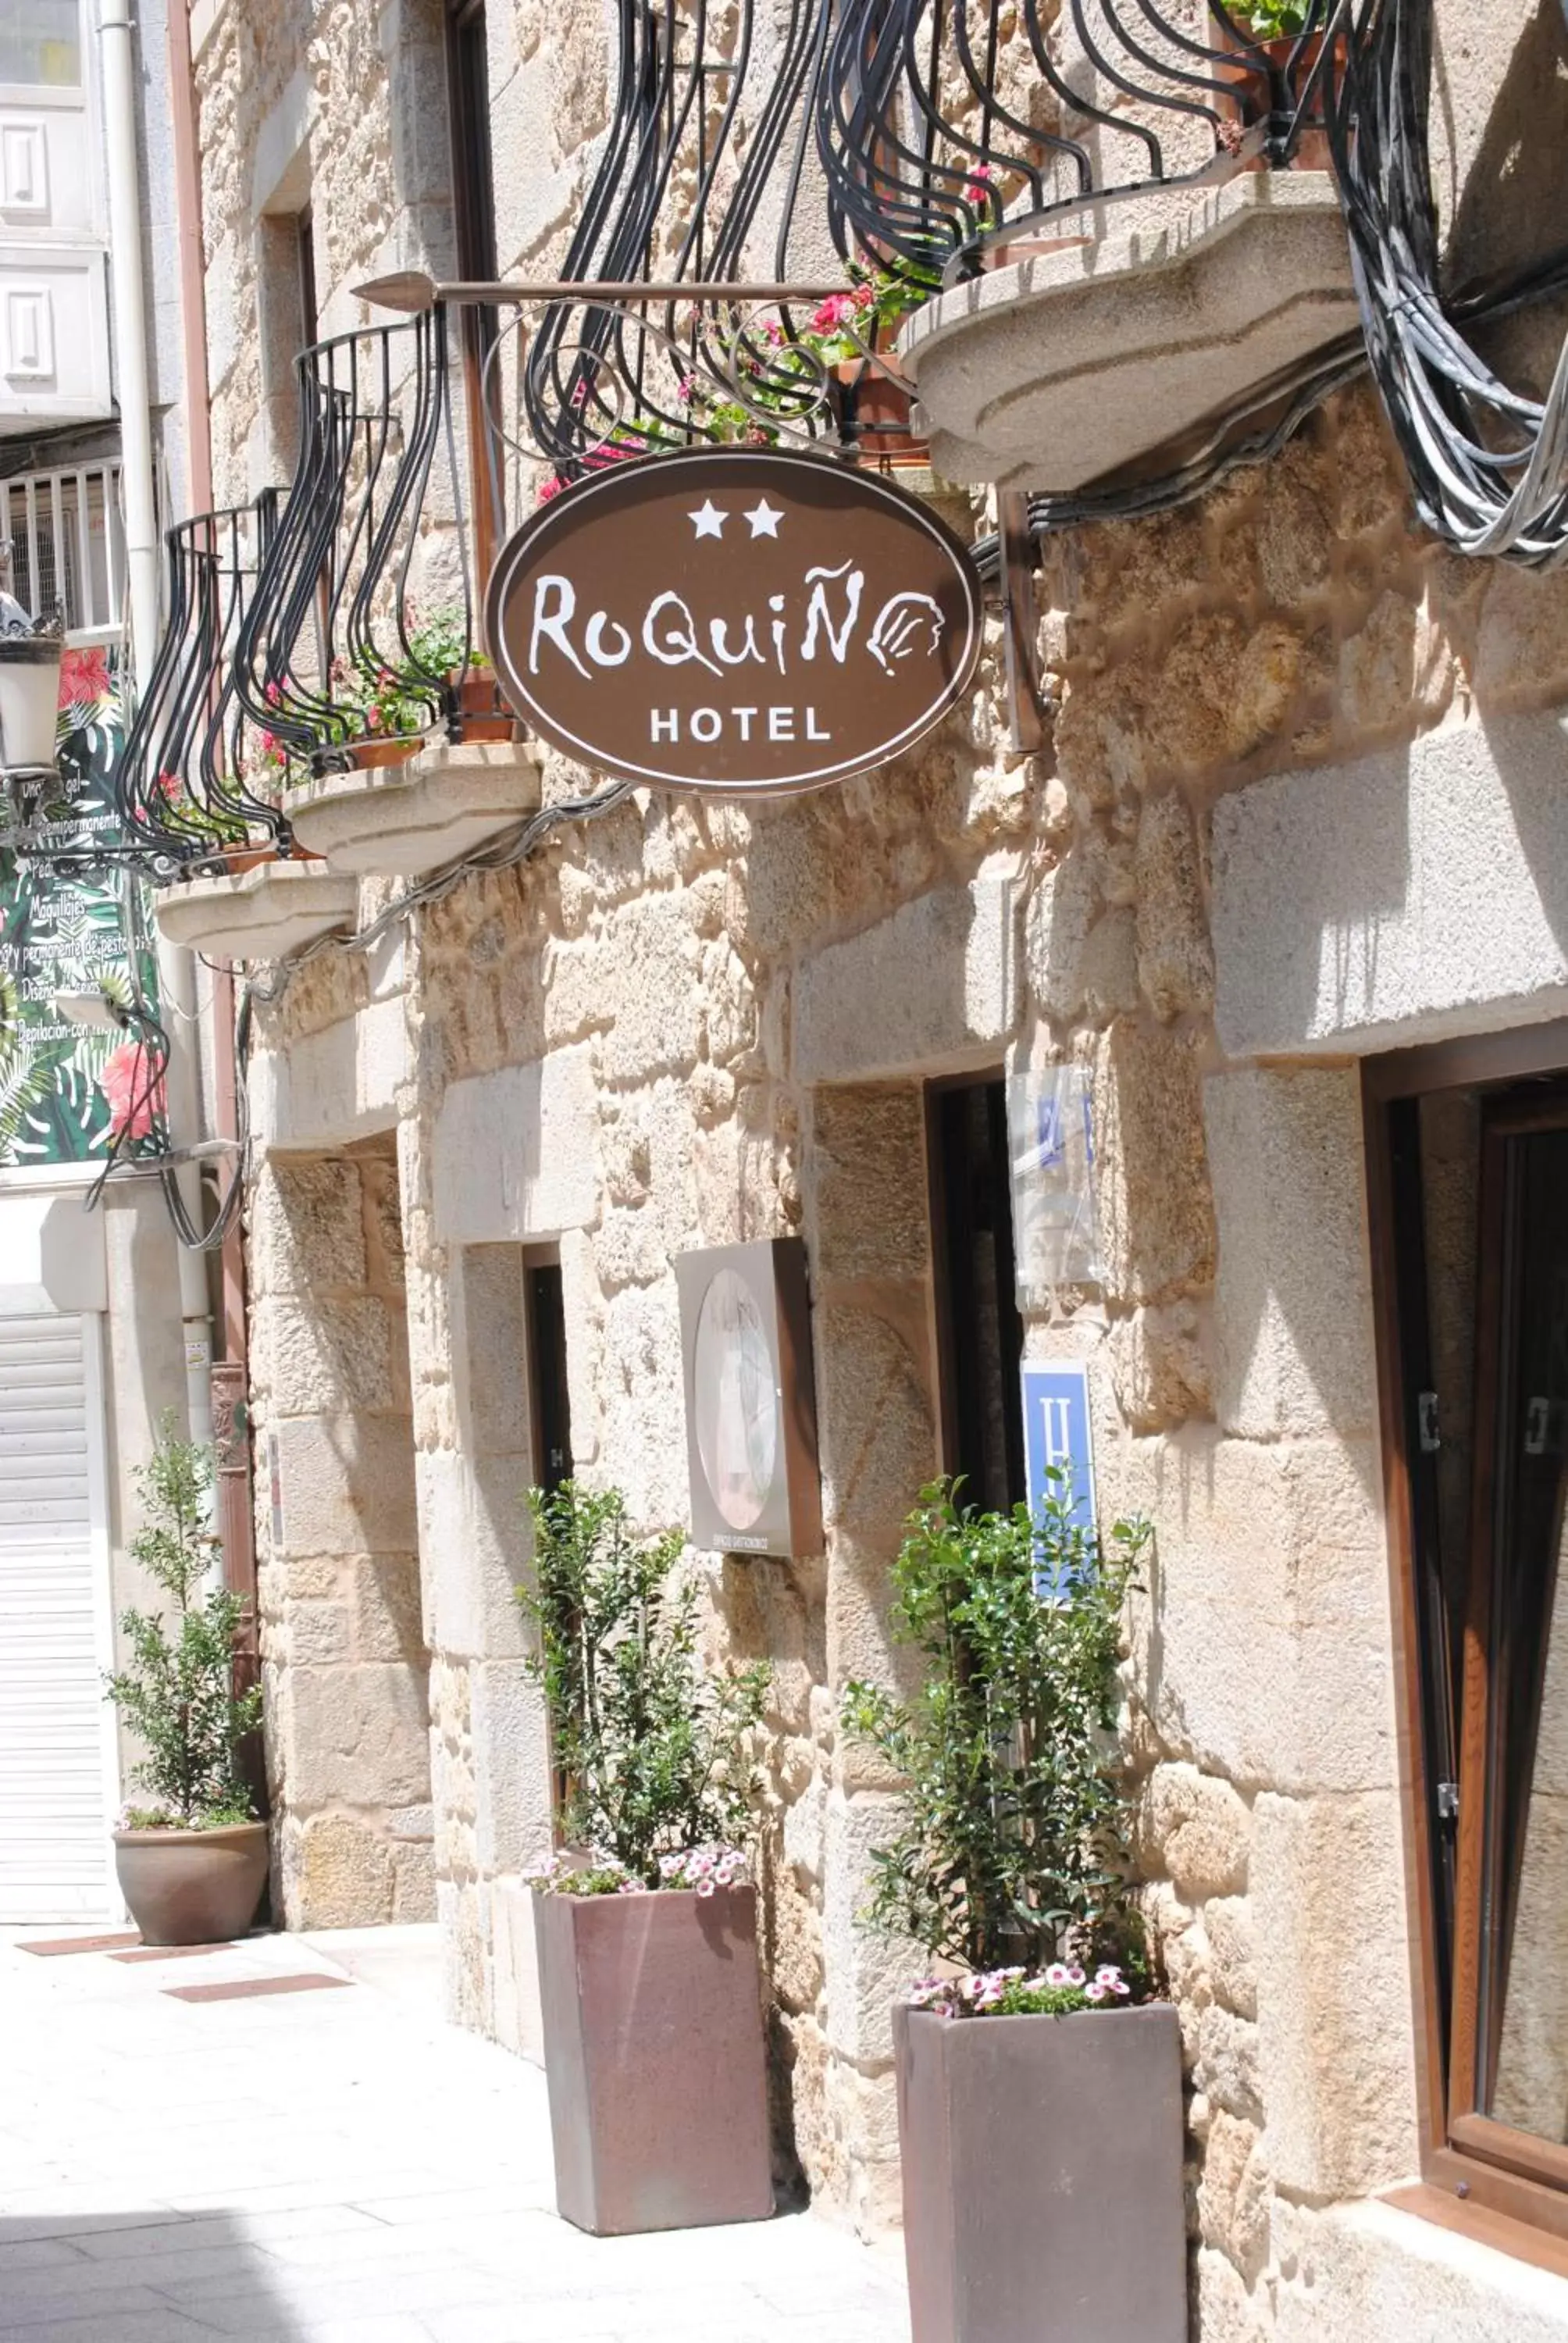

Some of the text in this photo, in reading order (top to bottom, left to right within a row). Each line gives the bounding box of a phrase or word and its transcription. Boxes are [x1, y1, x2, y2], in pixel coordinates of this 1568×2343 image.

[650, 706, 832, 743] HOTEL
[30, 893, 85, 928] Maquillajes
[1039, 1397, 1073, 1514] H
